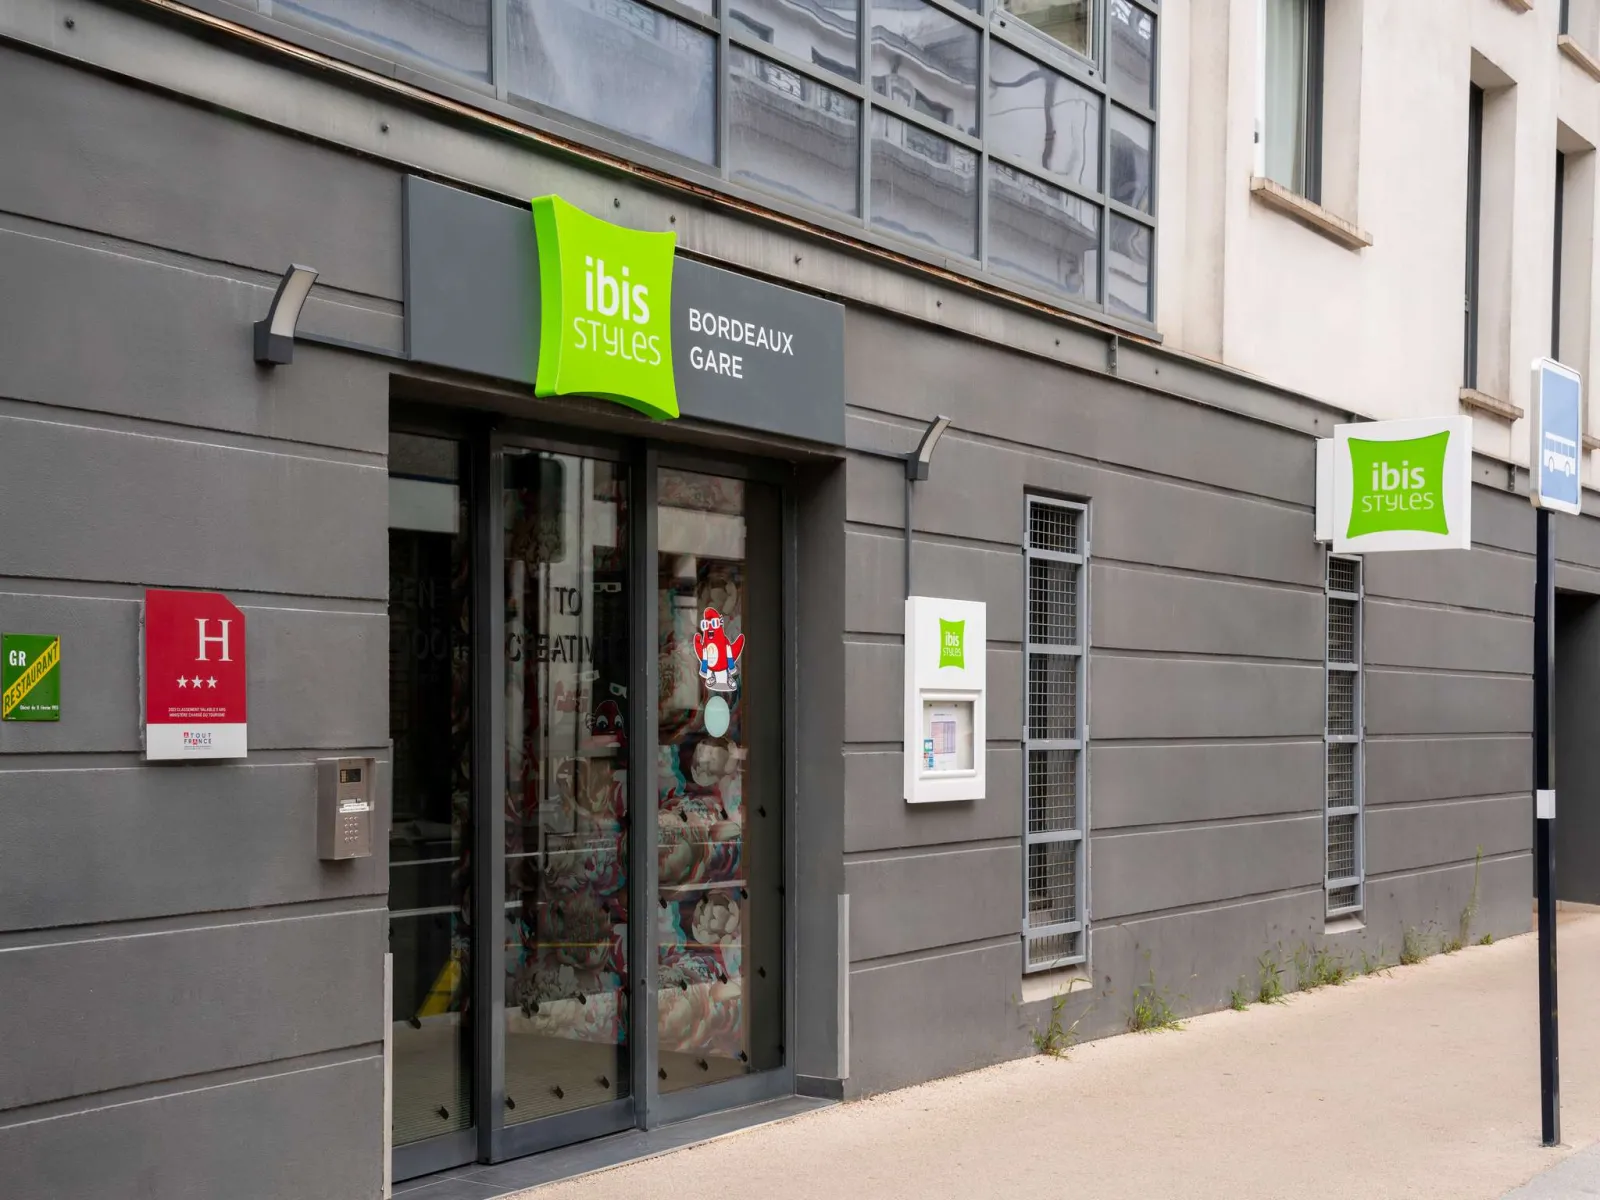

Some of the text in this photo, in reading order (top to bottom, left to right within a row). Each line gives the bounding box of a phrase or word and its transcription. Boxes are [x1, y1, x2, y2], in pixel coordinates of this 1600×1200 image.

[585, 255, 650, 324] ibis
[573, 317, 661, 365] STYLES
[689, 308, 794, 355] BORDEAUX
[690, 346, 743, 379] GARE
[1372, 460, 1425, 491] ibis
[1361, 492, 1434, 513] STYLES
[554, 586, 582, 617] TO
[194, 617, 234, 662] H
[945, 632, 960, 647] ibis
[9, 650, 26, 665] GR
[4, 642, 59, 711] RESTAURANT
